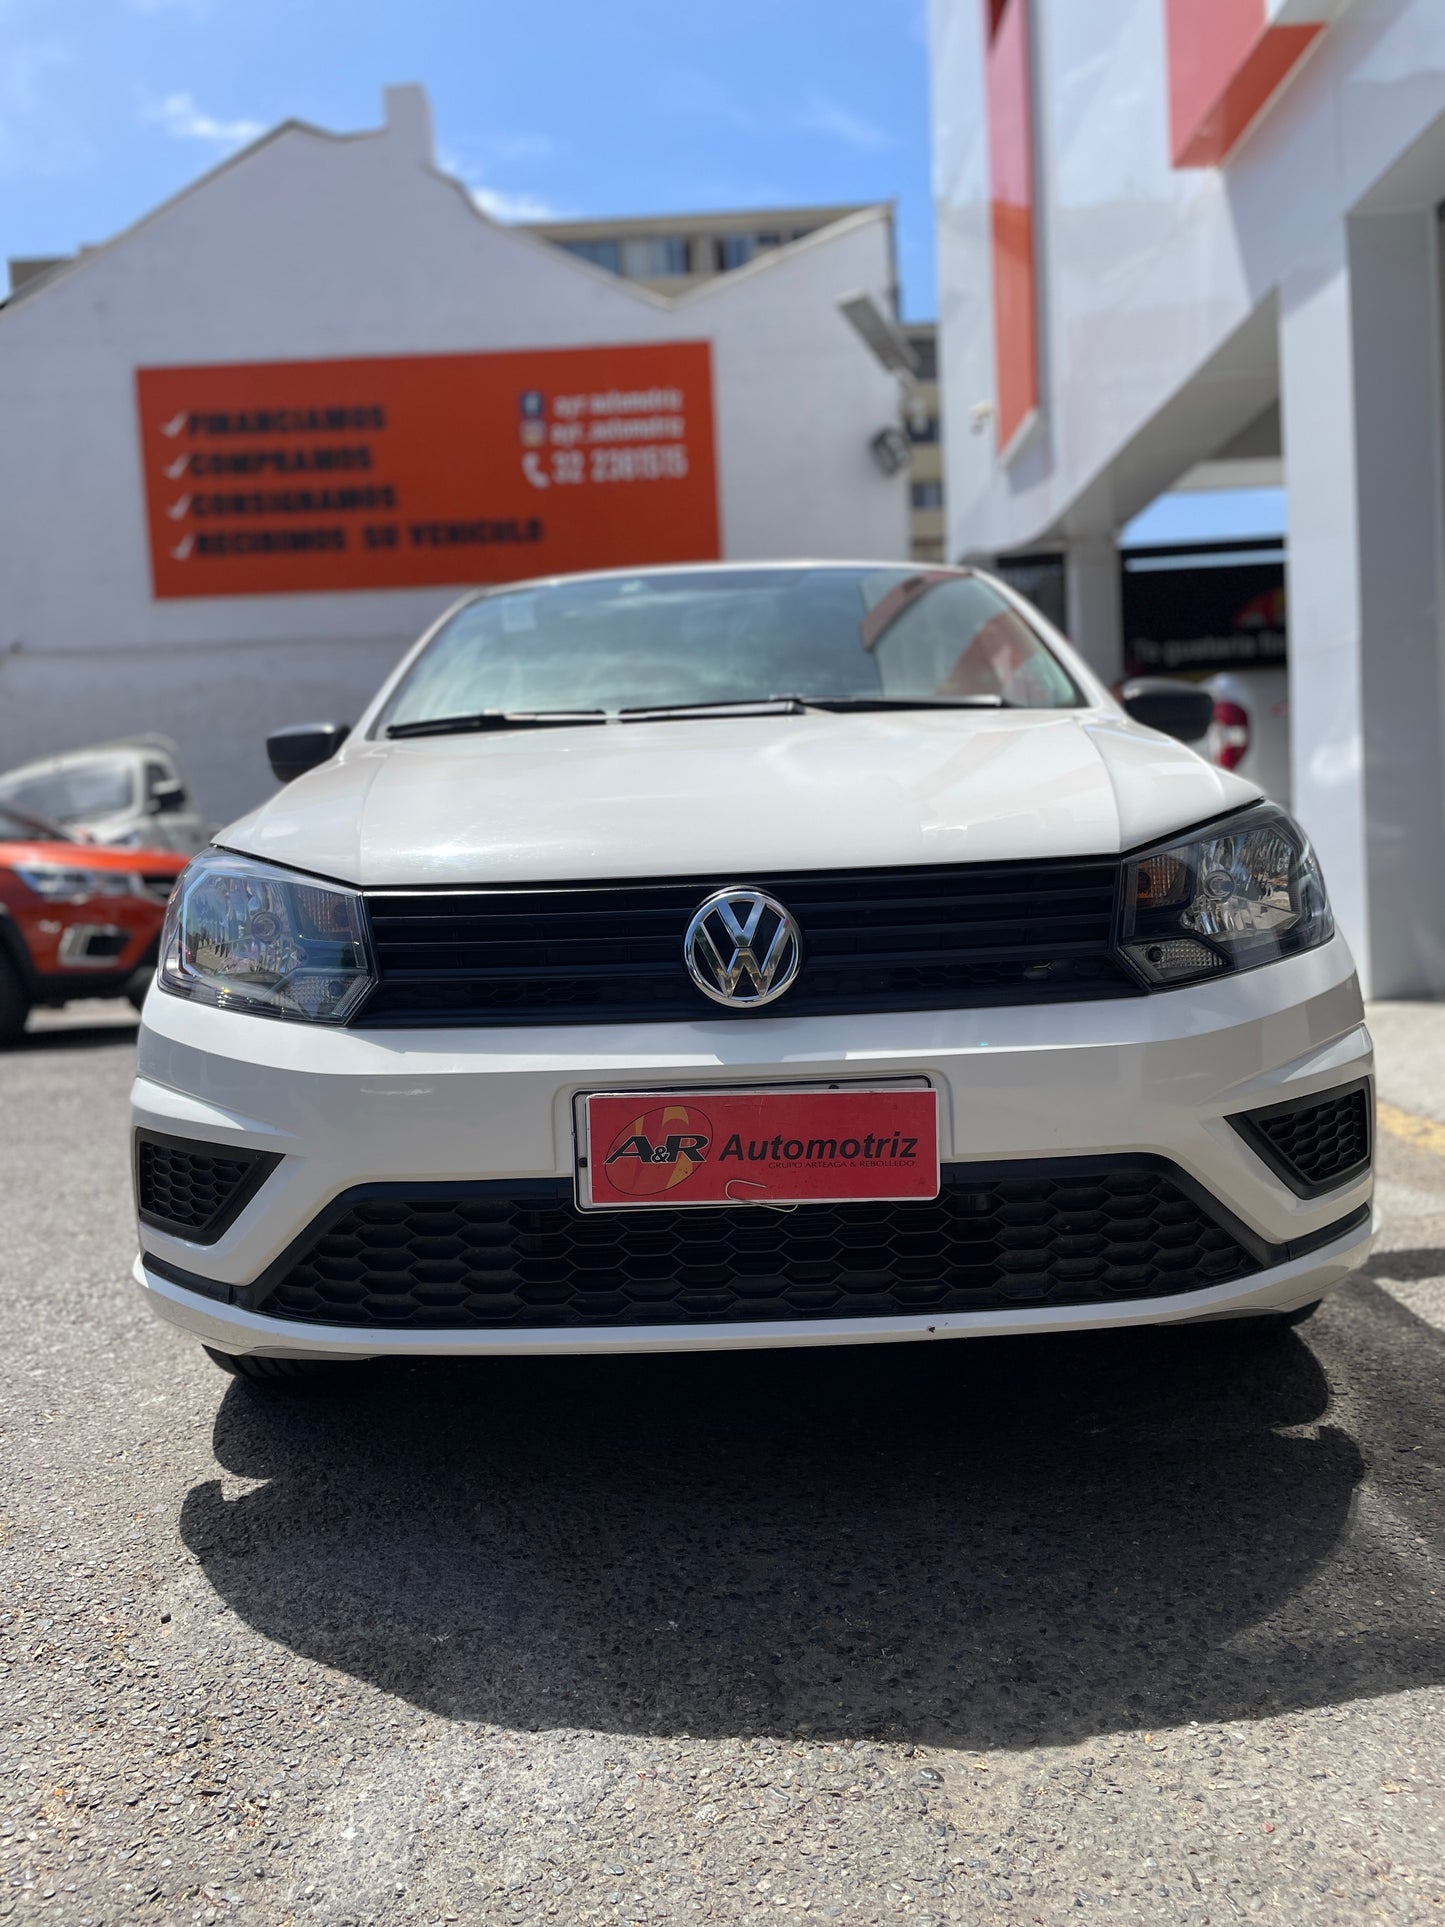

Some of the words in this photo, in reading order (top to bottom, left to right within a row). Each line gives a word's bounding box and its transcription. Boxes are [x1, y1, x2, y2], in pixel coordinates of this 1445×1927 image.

[189, 407, 384, 437] FINANCIAMOS
[191, 447, 371, 477] COMPRAMOS
[193, 486, 395, 519] CONSIGNAMOS
[198, 527, 346, 557] RECIBIMOS
[363, 523, 396, 552] SU
[603, 1134, 710, 1164] A&R
[719, 1131, 918, 1161] Automotriz
